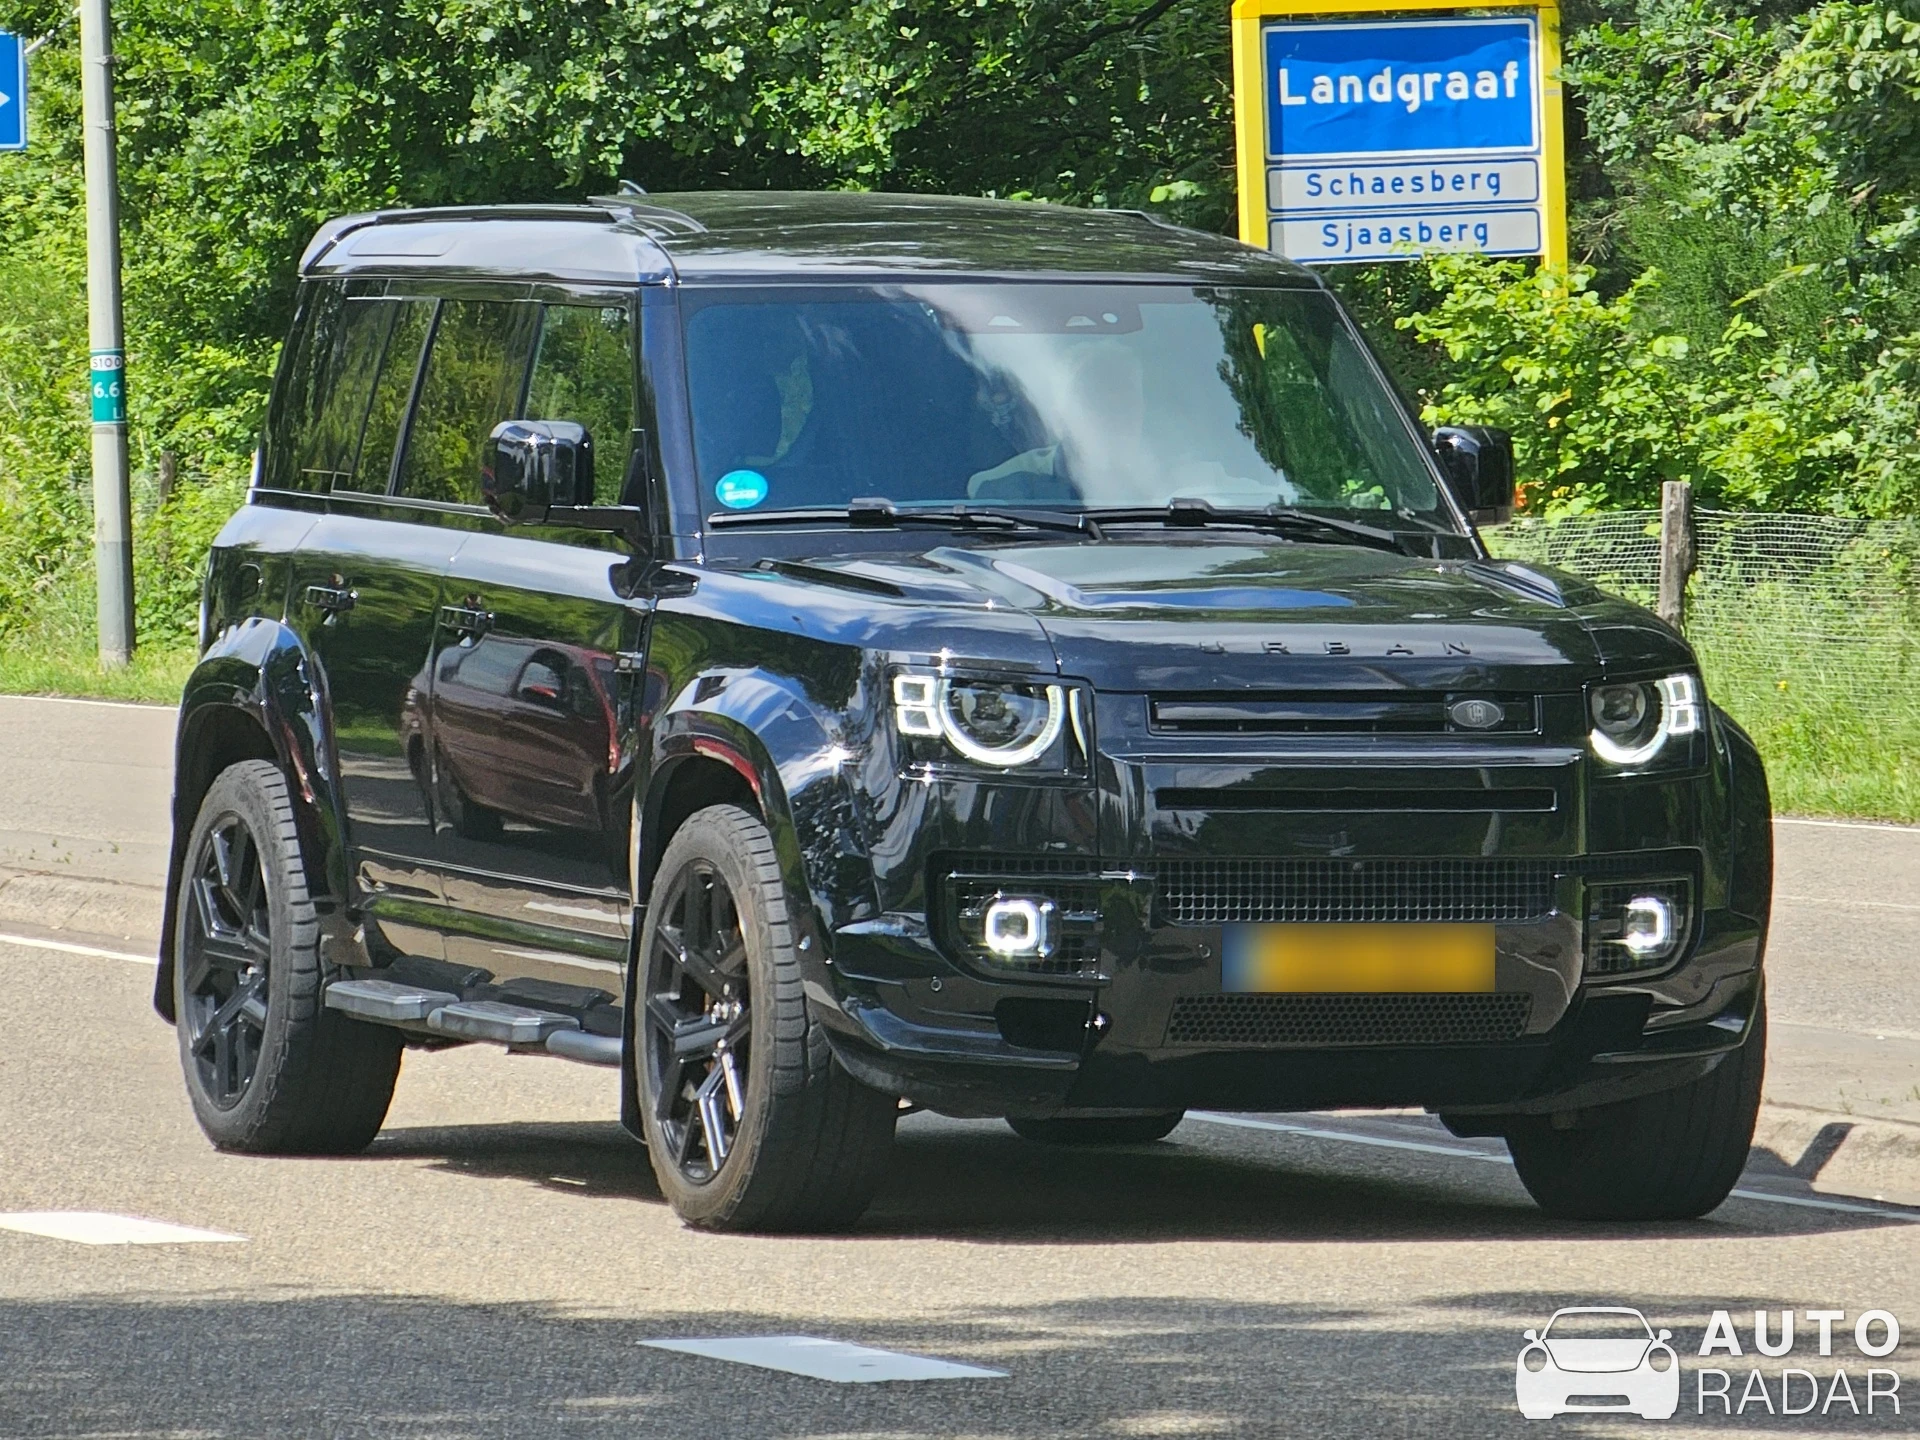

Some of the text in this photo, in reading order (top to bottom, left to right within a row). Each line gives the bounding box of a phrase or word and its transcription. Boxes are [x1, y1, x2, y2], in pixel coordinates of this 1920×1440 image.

[1279, 61, 1519, 113] Landgraaf
[1306, 169, 1501, 197] Schaesberg
[1322, 222, 1489, 252] Sjaasberg
[92, 357, 121, 368] S100
[93, 381, 120, 398] 6.6
[1199, 640, 1472, 655] URBAN
